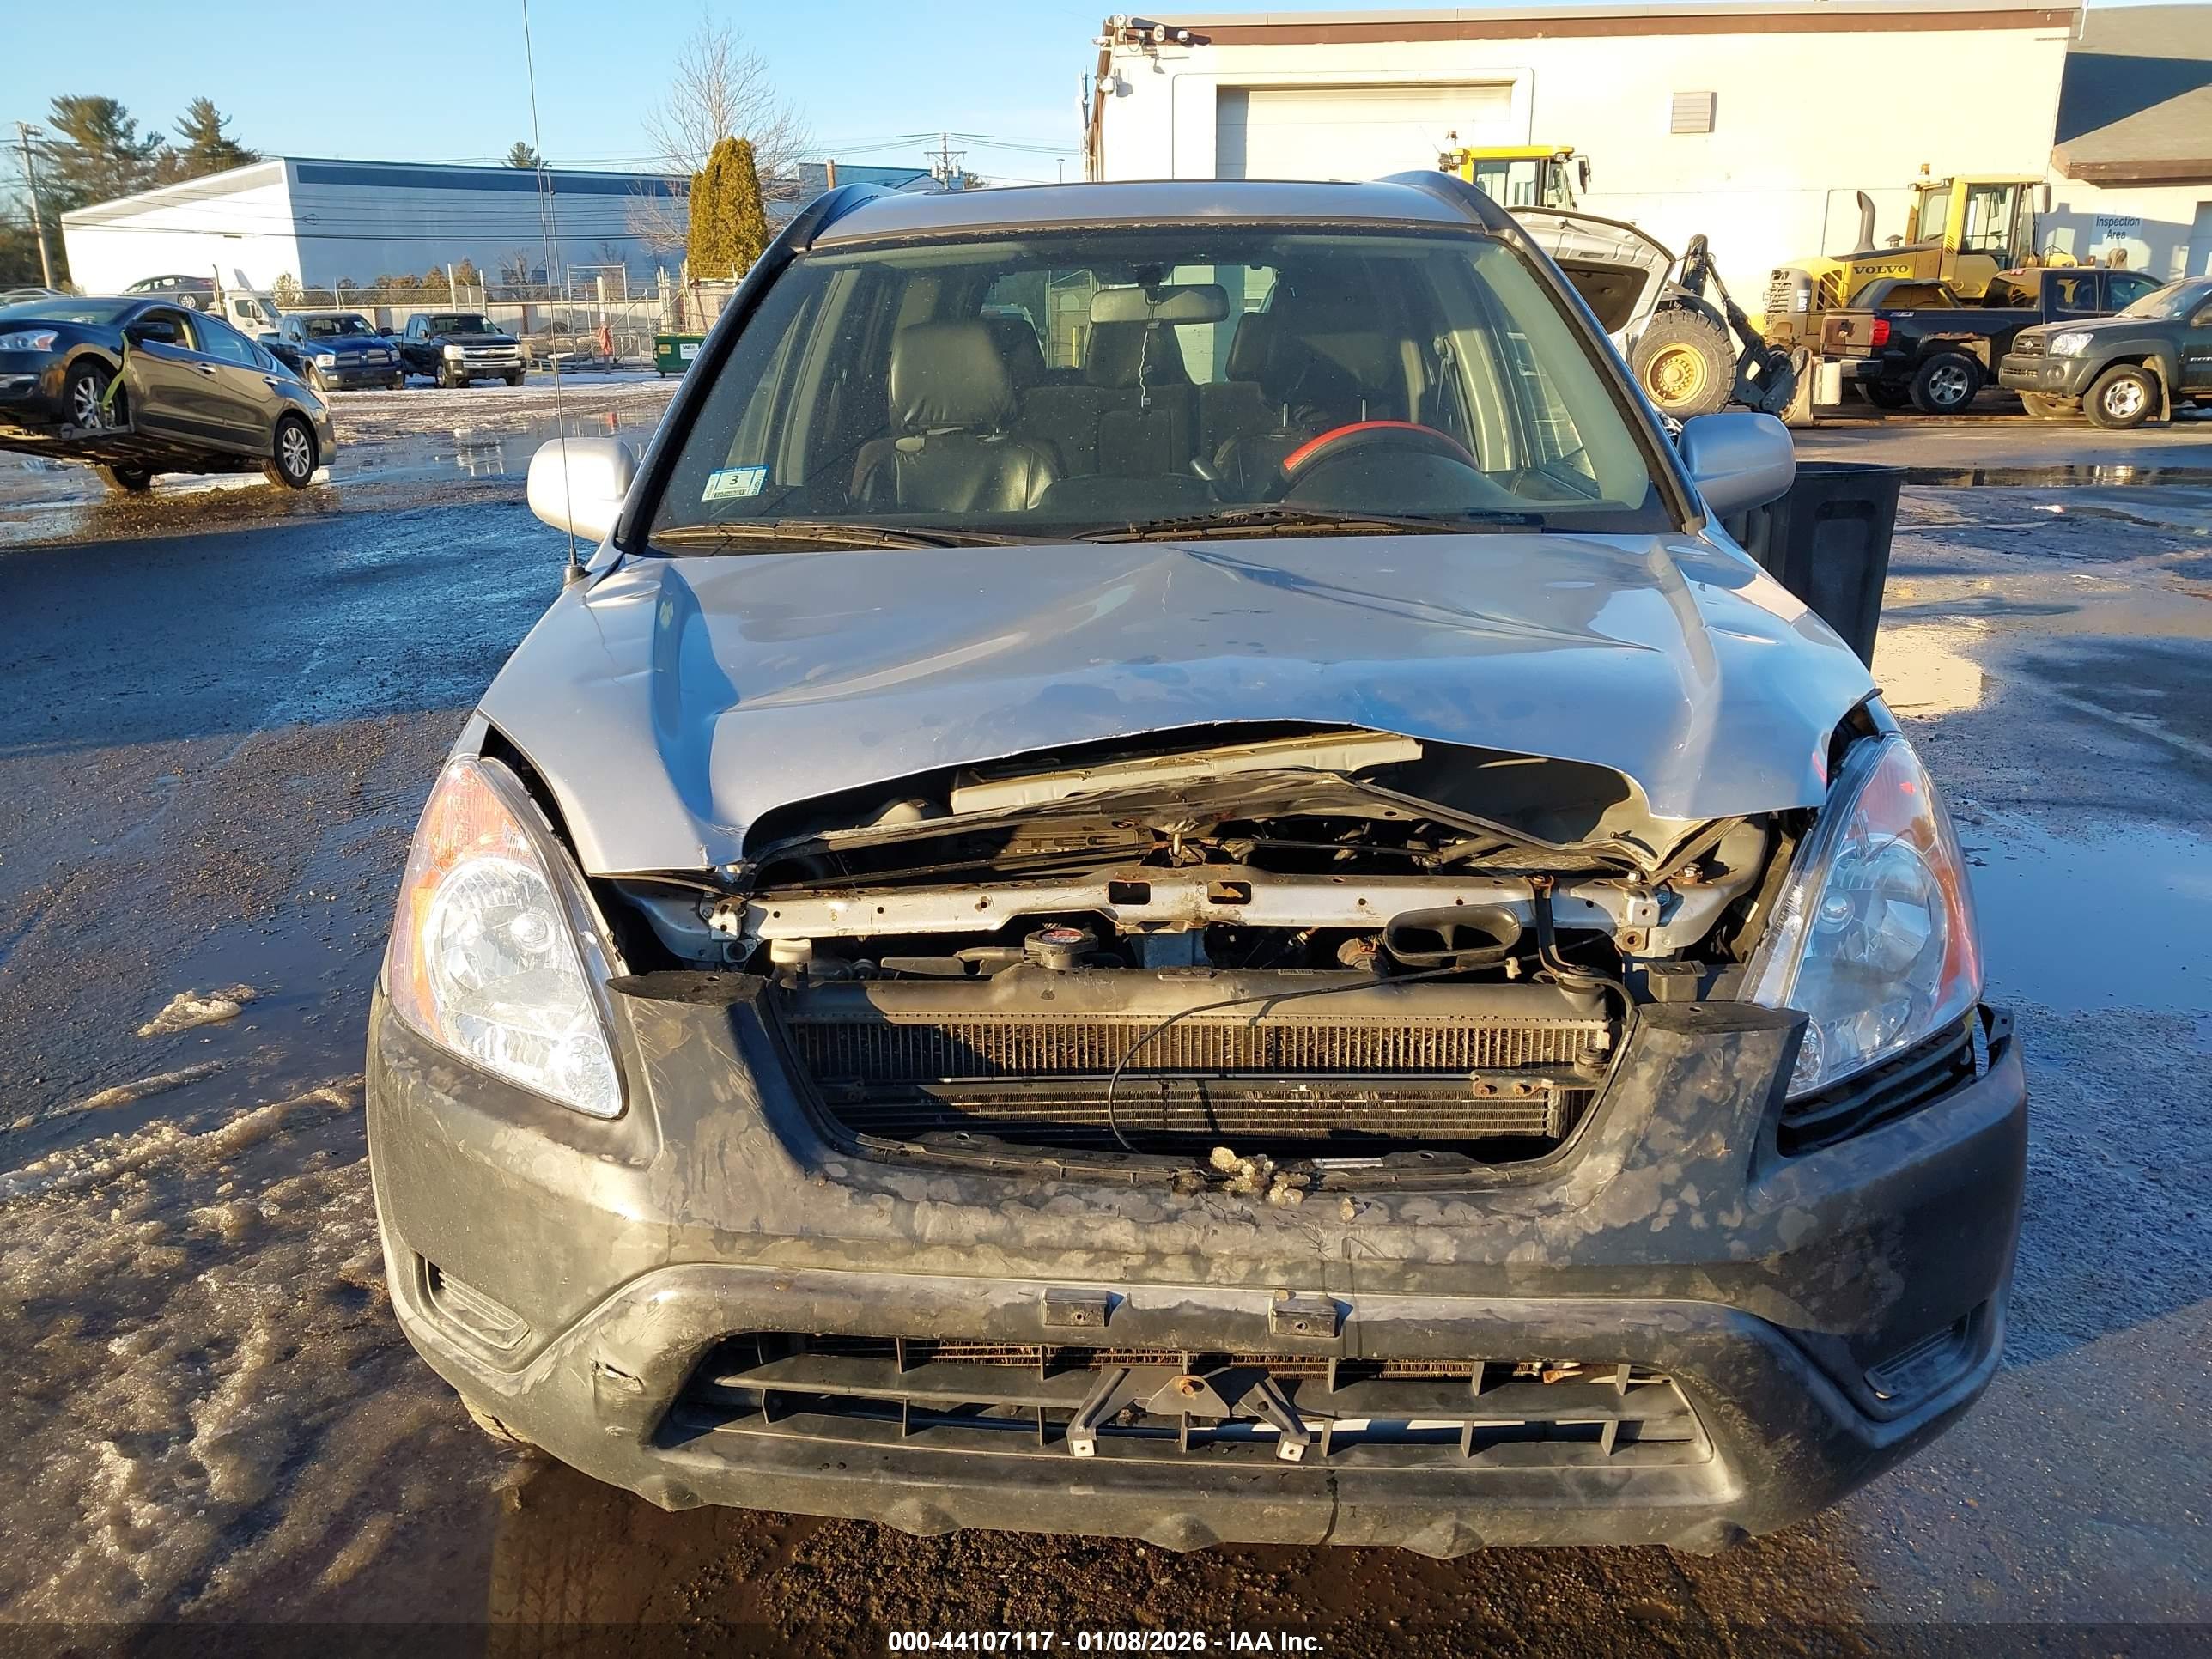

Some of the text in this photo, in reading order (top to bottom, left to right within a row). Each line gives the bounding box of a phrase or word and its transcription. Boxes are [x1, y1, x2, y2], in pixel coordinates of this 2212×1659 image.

[2096, 216, 2141, 228] Inspection
[2106, 229, 2126, 240] Area
[1852, 265, 1909, 275] VOLVO
[729, 475, 739, 485] 3
